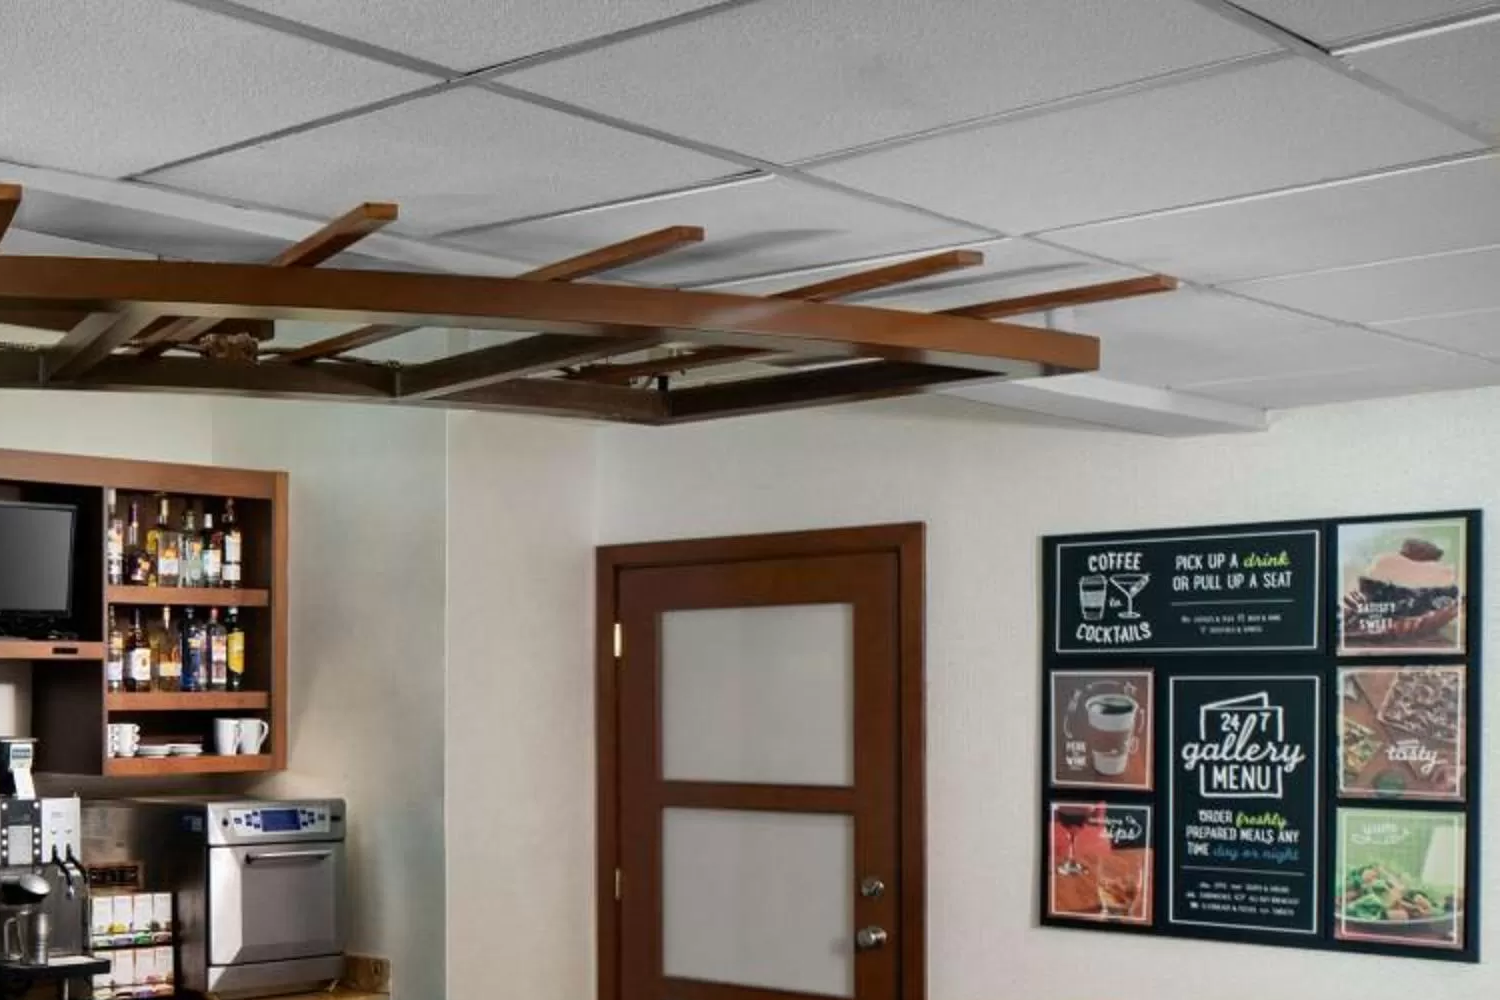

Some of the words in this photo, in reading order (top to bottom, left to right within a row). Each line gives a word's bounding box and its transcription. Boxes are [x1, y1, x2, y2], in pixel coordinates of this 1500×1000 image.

[1088, 552, 1143, 572] COFFEE
[1175, 554, 1203, 570] PICK
[1208, 553, 1226, 569] UP
[1229, 553, 1239, 568] A
[1243, 550, 1291, 568] drink
[1172, 575, 1190, 591] OR
[1193, 574, 1222, 591] PULL
[1227, 573, 1245, 589] UP
[1249, 573, 1259, 588] A
[1263, 571, 1292, 588] SEAT
[1076, 622, 1152, 643] COCKTAILS
[1220, 712, 1240, 732] 24
[1181, 713, 1307, 773] gallery
[1384, 745, 1448, 775] tasty
[1213, 764, 1271, 790] MENU
[1198, 809, 1233, 823] ORDER
[1186, 825, 1238, 841] PREPARED
[1240, 829, 1275, 844] MEALS
[1277, 830, 1300, 843] ANY
